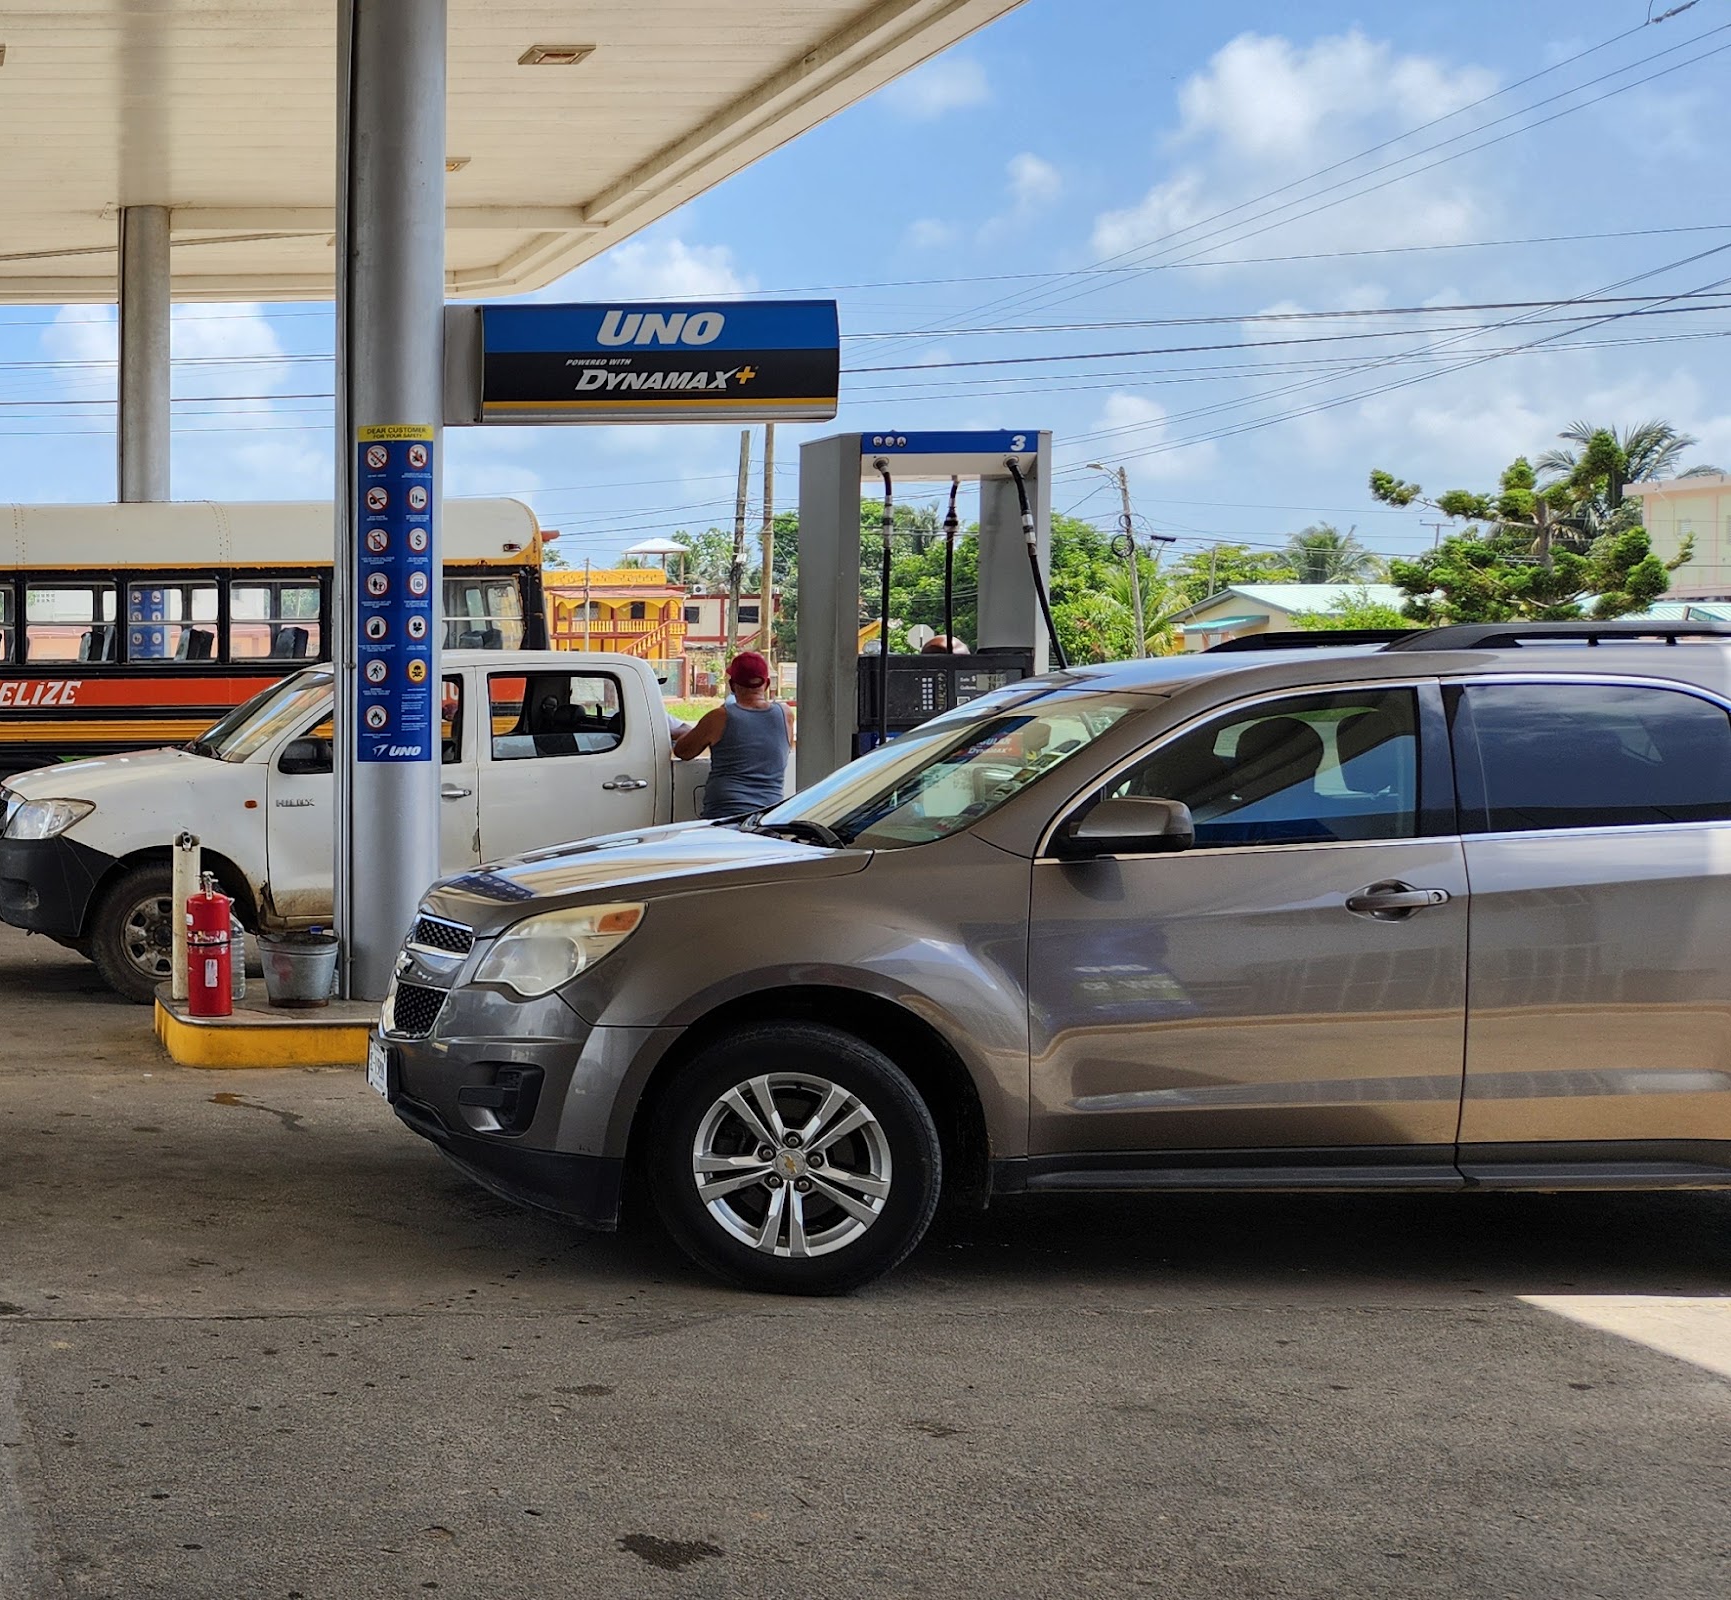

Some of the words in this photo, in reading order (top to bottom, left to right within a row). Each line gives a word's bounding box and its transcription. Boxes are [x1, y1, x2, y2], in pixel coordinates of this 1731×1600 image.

[596, 310, 726, 346] UNO
[565, 358, 607, 366] POWERED
[608, 358, 633, 366] WITH
[1010, 434, 1027, 452] 3
[388, 745, 422, 757] UNO
